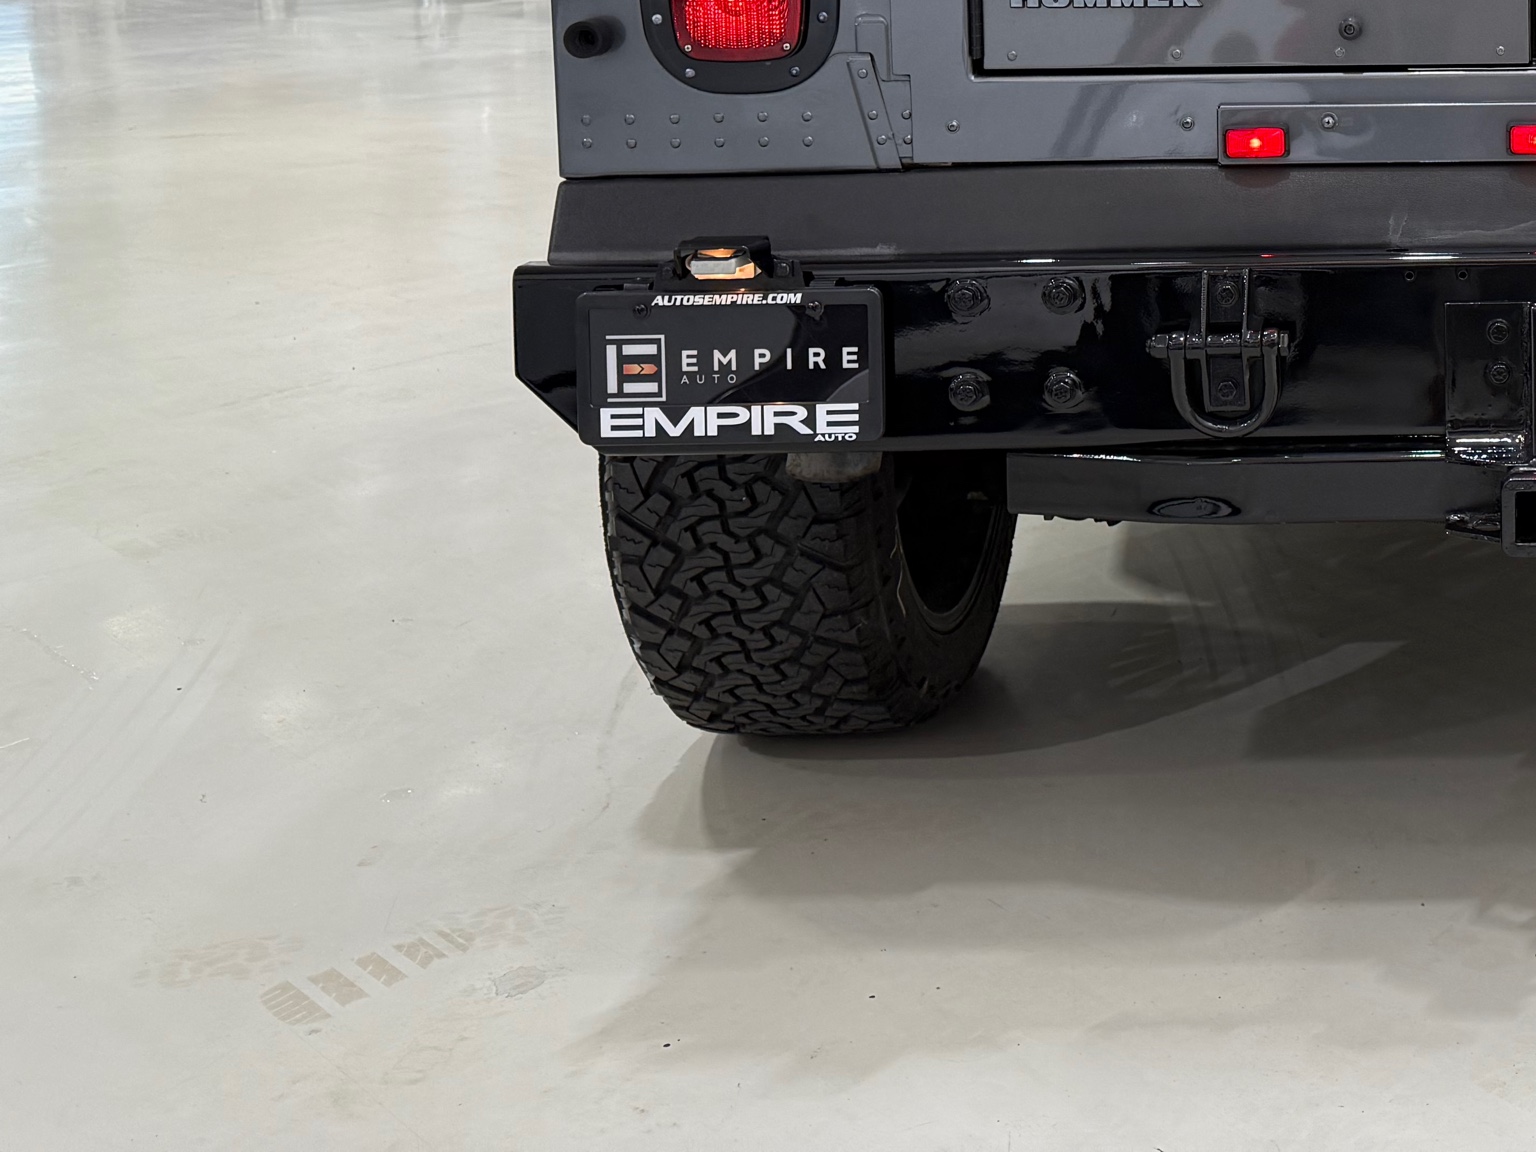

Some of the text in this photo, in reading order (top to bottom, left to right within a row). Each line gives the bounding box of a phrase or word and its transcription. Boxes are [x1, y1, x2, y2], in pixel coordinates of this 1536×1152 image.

[651, 292, 802, 307] AUTOSEMPIRE.COM
[681, 346, 860, 373] EMPIRE
[681, 374, 737, 385] AUTO
[600, 403, 860, 438] EMPIRE
[814, 432, 857, 442] AUTO
